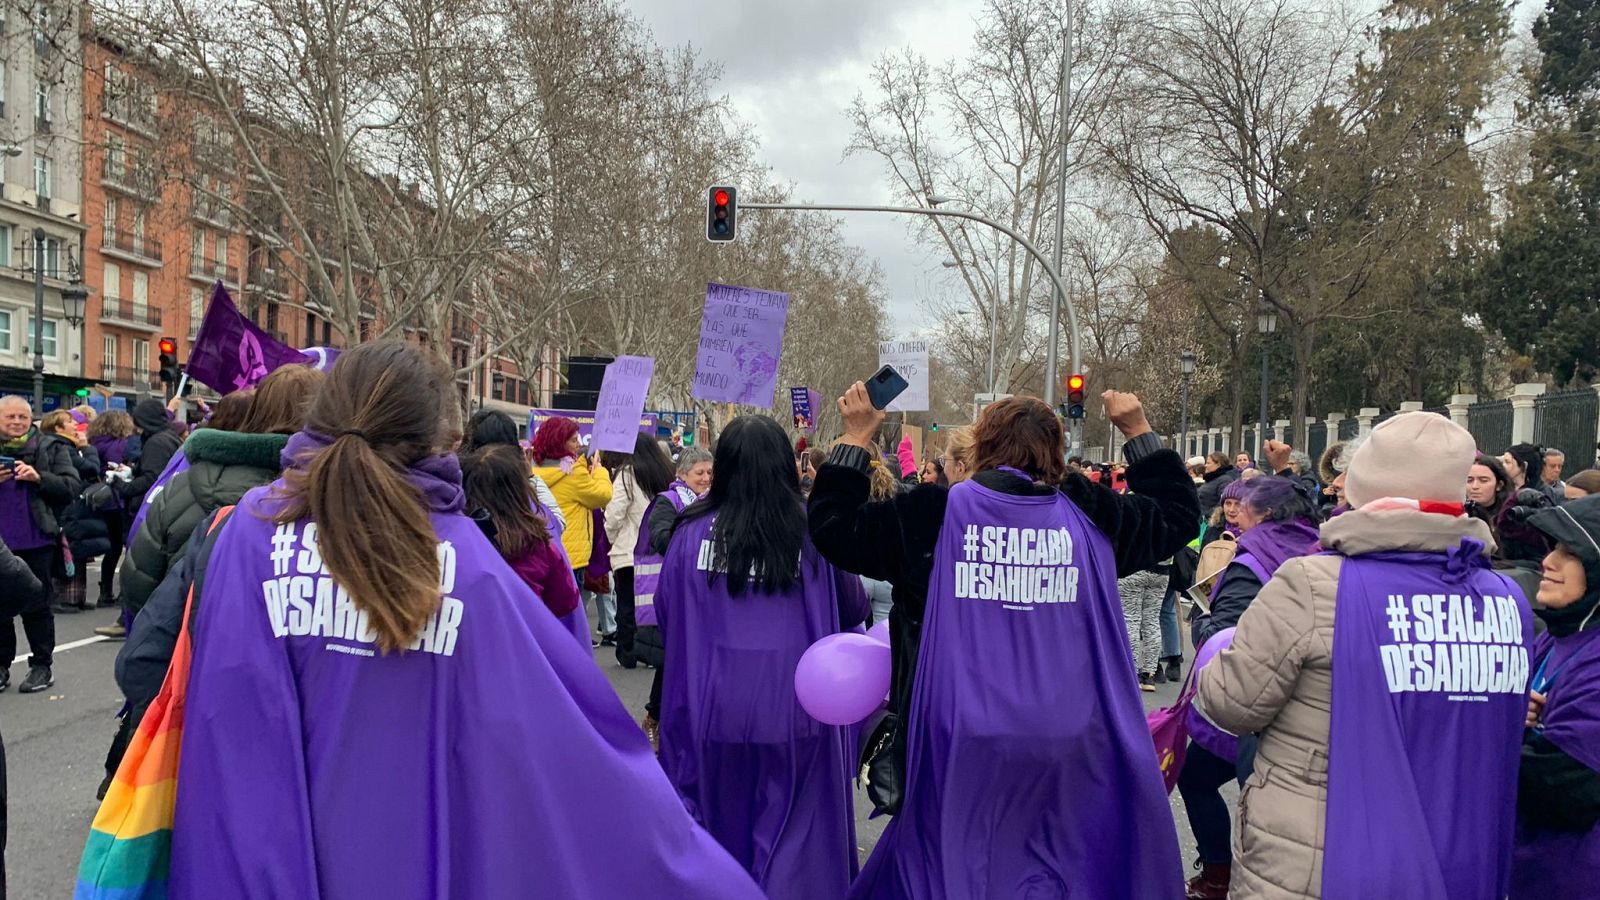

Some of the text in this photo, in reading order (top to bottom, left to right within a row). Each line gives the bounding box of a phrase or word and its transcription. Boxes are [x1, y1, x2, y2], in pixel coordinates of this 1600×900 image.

[723, 303, 741, 318] QUE
[705, 320, 750, 338] LAS QUE
[879, 343, 896, 355] NOS
[705, 355, 717, 368] EL
[695, 371, 729, 390] MUNDO
[963, 524, 1074, 566] #SEACABÓ
[955, 561, 1080, 604] DESAHUCIAR
[1379, 643, 1530, 695] DESAHUCIAR
